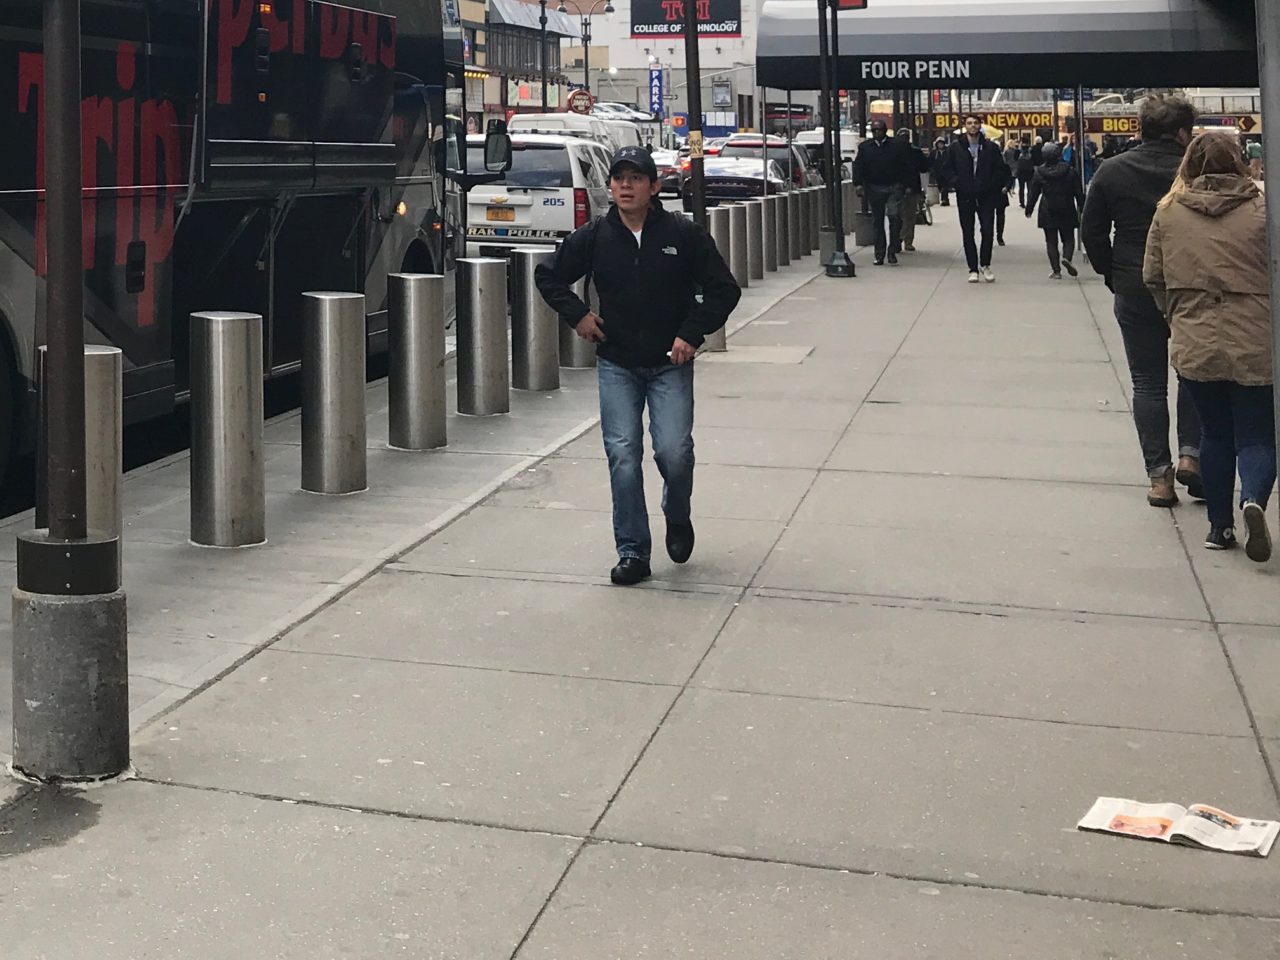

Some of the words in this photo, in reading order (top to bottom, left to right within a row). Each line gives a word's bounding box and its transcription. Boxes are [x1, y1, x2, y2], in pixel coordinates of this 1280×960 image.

[634, 24, 668, 33] COLLEGE
[670, 24, 682, 32] OF
[861, 61, 910, 79] FOUR
[915, 60, 969, 79] PENN
[651, 71, 660, 103] PARK
[987, 114, 1020, 128] NEW
[543, 198, 565, 206] 205
[467, 228, 496, 236] RAK
[508, 229, 558, 238] POLICE
